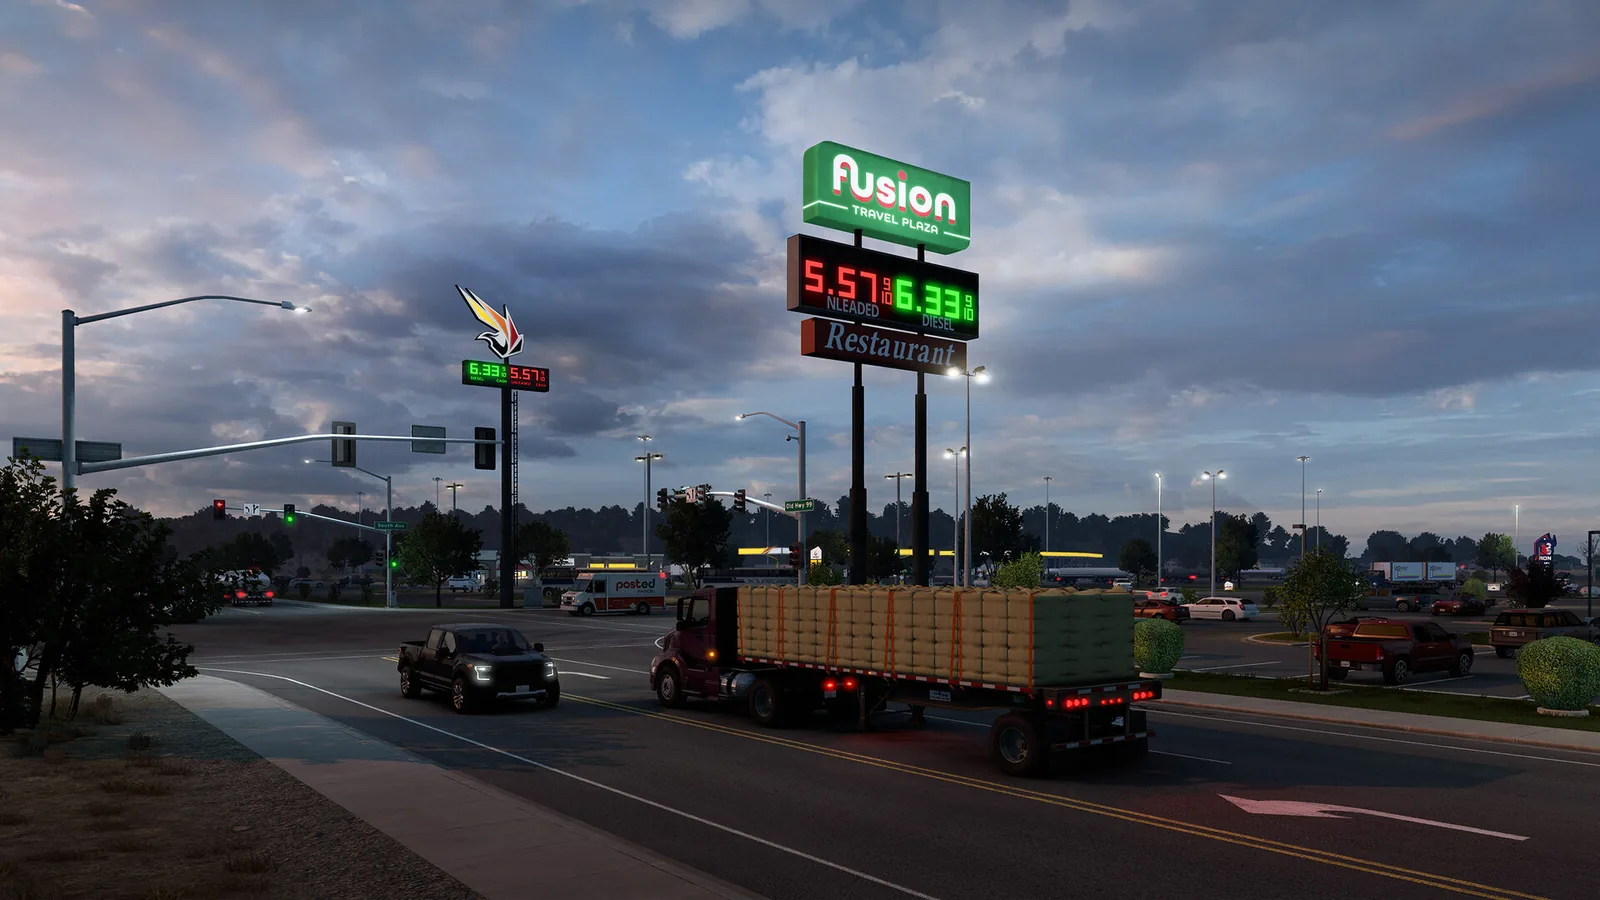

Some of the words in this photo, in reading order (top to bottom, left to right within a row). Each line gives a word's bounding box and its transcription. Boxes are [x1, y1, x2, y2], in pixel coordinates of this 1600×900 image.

[833, 153, 956, 224] fusion
[852, 204, 899, 225] TRAVEL
[902, 217, 938, 234] PLAZA
[805, 259, 877, 304] 5.57
[896, 278, 960, 320] 6.33
[922, 314, 954, 331] DIESEL
[825, 321, 955, 366] Restaurant
[469, 362, 500, 377] 6.33
[510, 367, 539, 382] 5.57
[615, 578, 655, 591] posted
